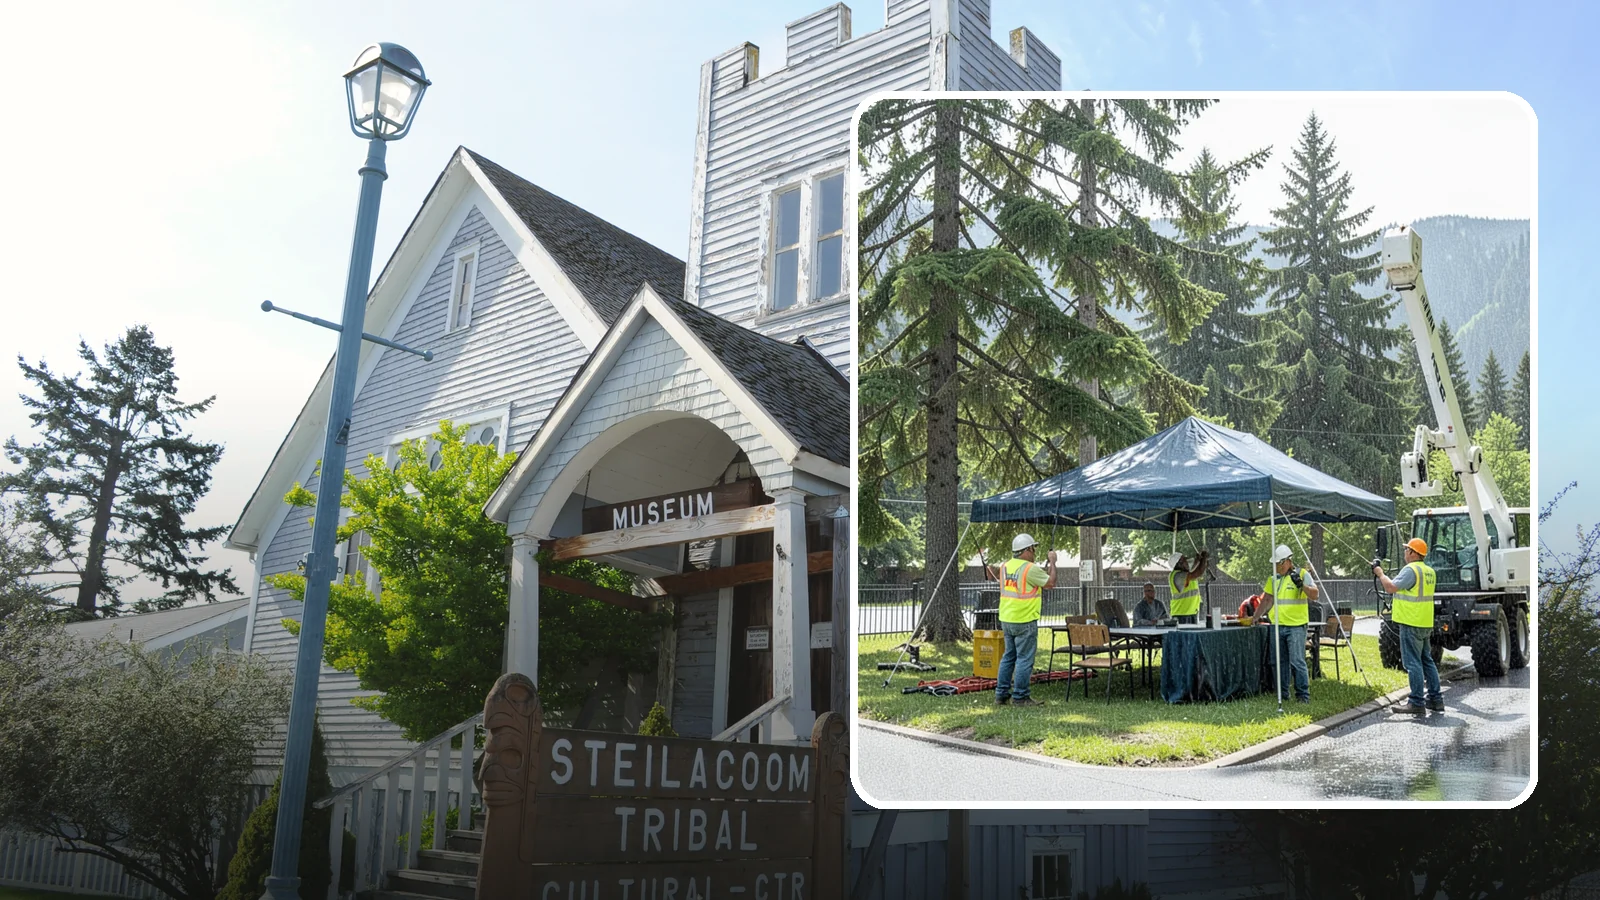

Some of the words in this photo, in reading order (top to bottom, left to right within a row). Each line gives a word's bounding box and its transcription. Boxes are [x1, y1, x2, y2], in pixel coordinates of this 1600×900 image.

[613, 491, 713, 531] MUSEUM
[550, 738, 809, 793] STEILACOOM
[615, 806, 758, 852] TRIBAL
